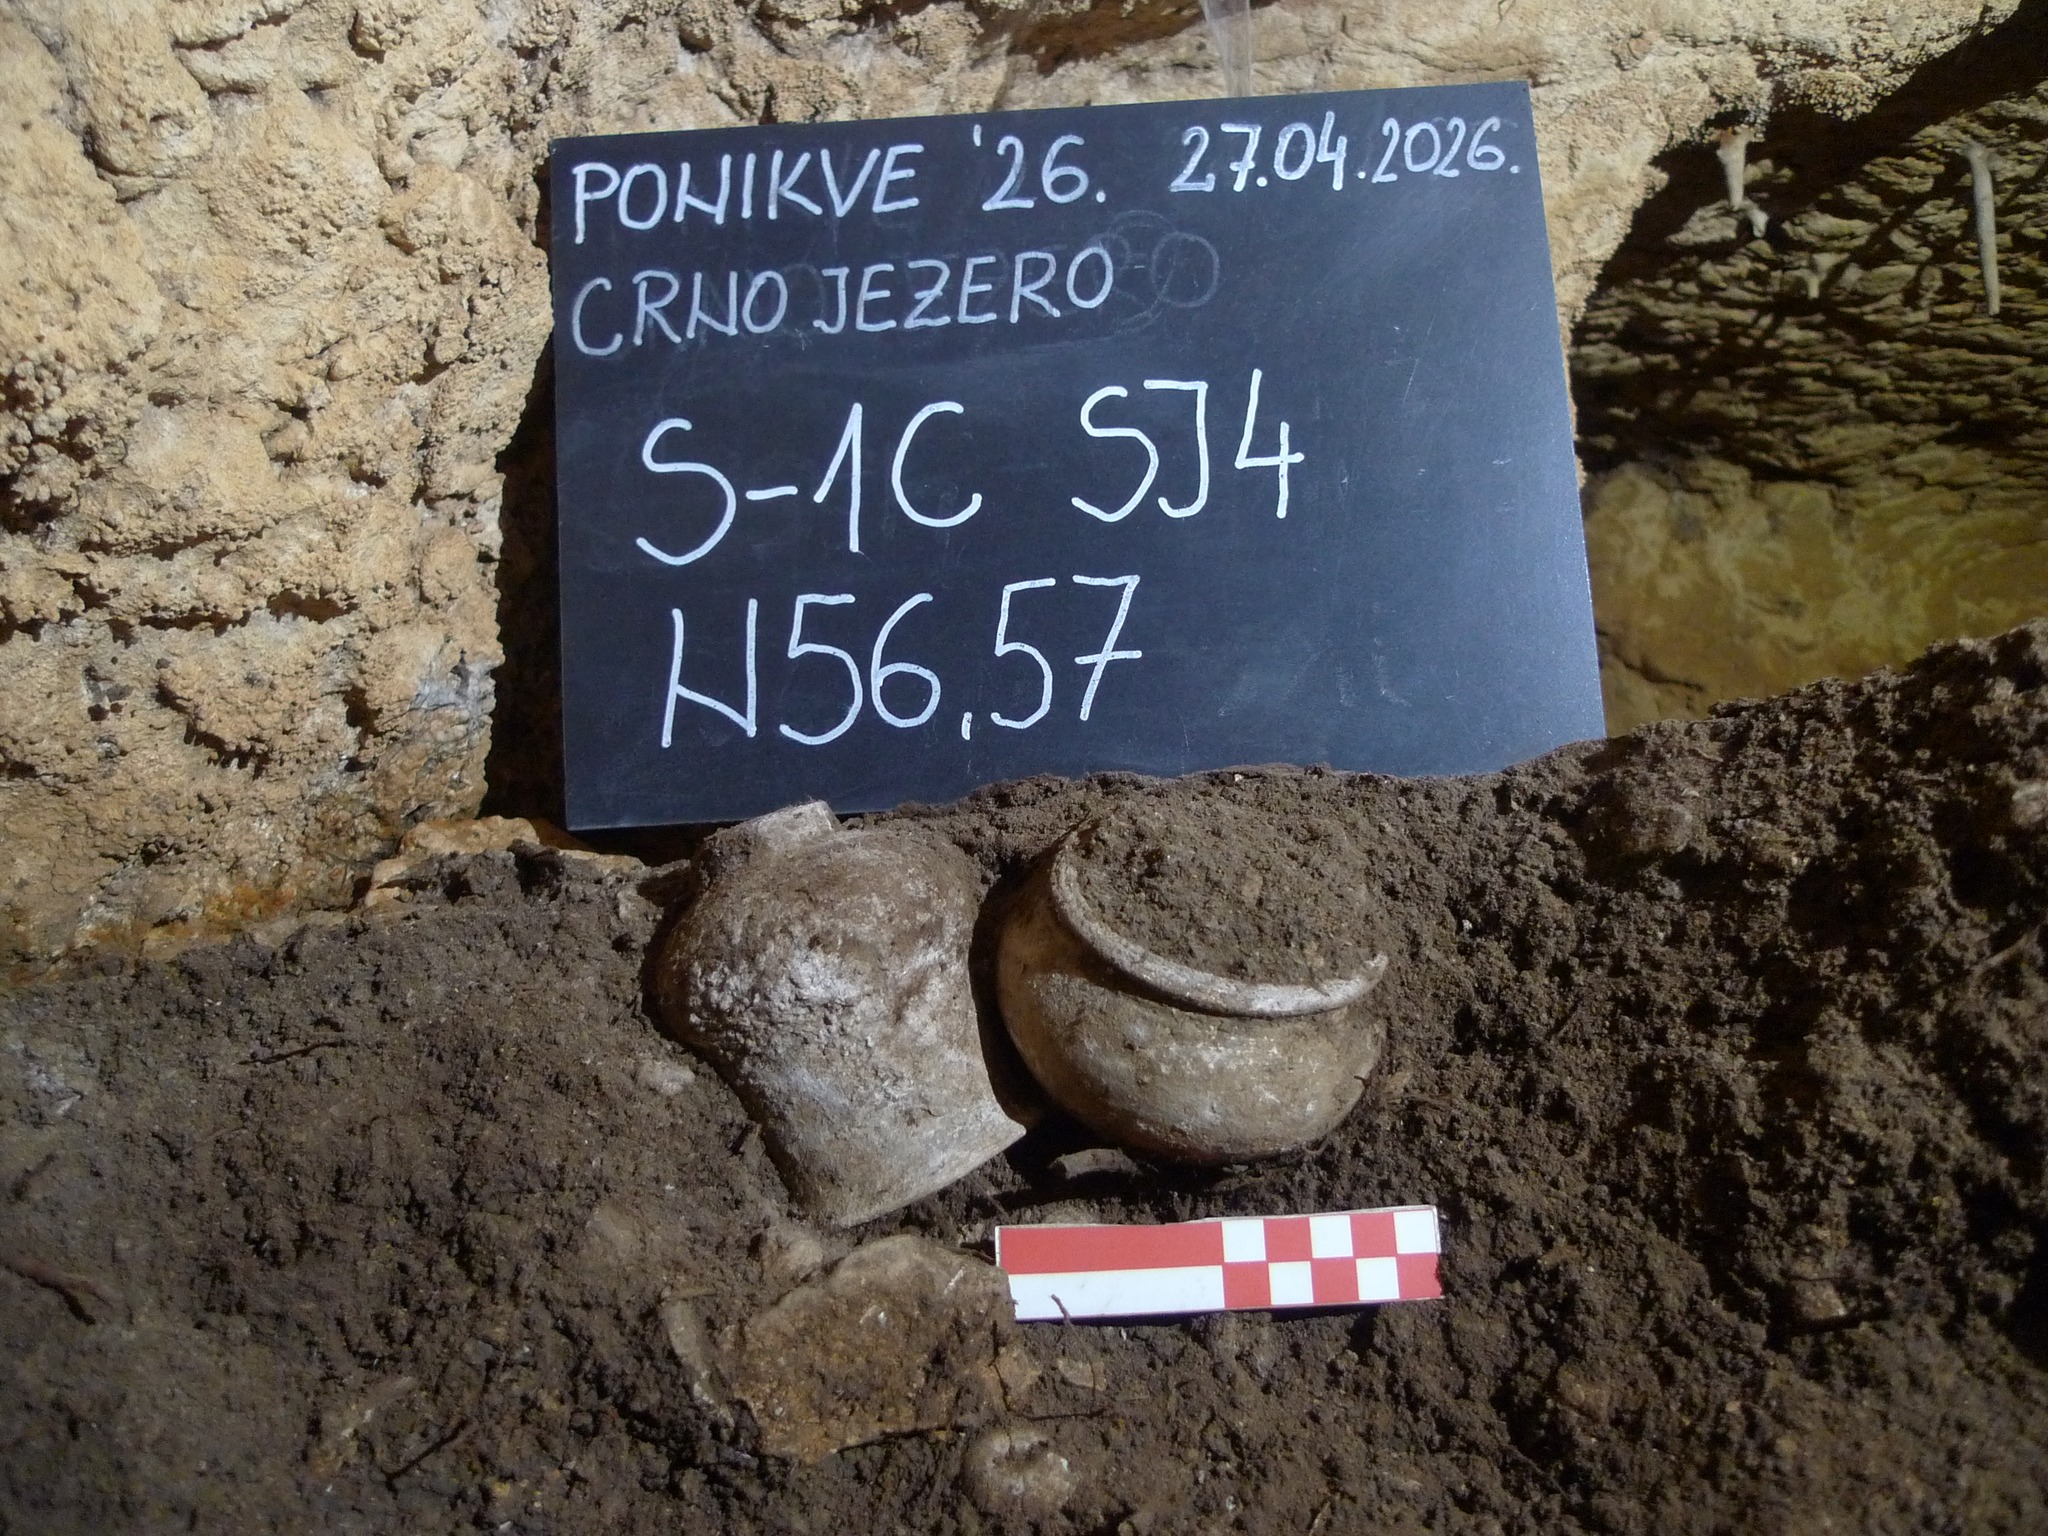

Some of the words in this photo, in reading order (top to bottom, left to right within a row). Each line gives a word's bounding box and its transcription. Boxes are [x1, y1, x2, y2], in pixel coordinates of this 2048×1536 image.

[572, 144, 925, 246] PONIKVE
[572, 268, 790, 357] CRNO
[811, 242, 1115, 336] JEZERO
